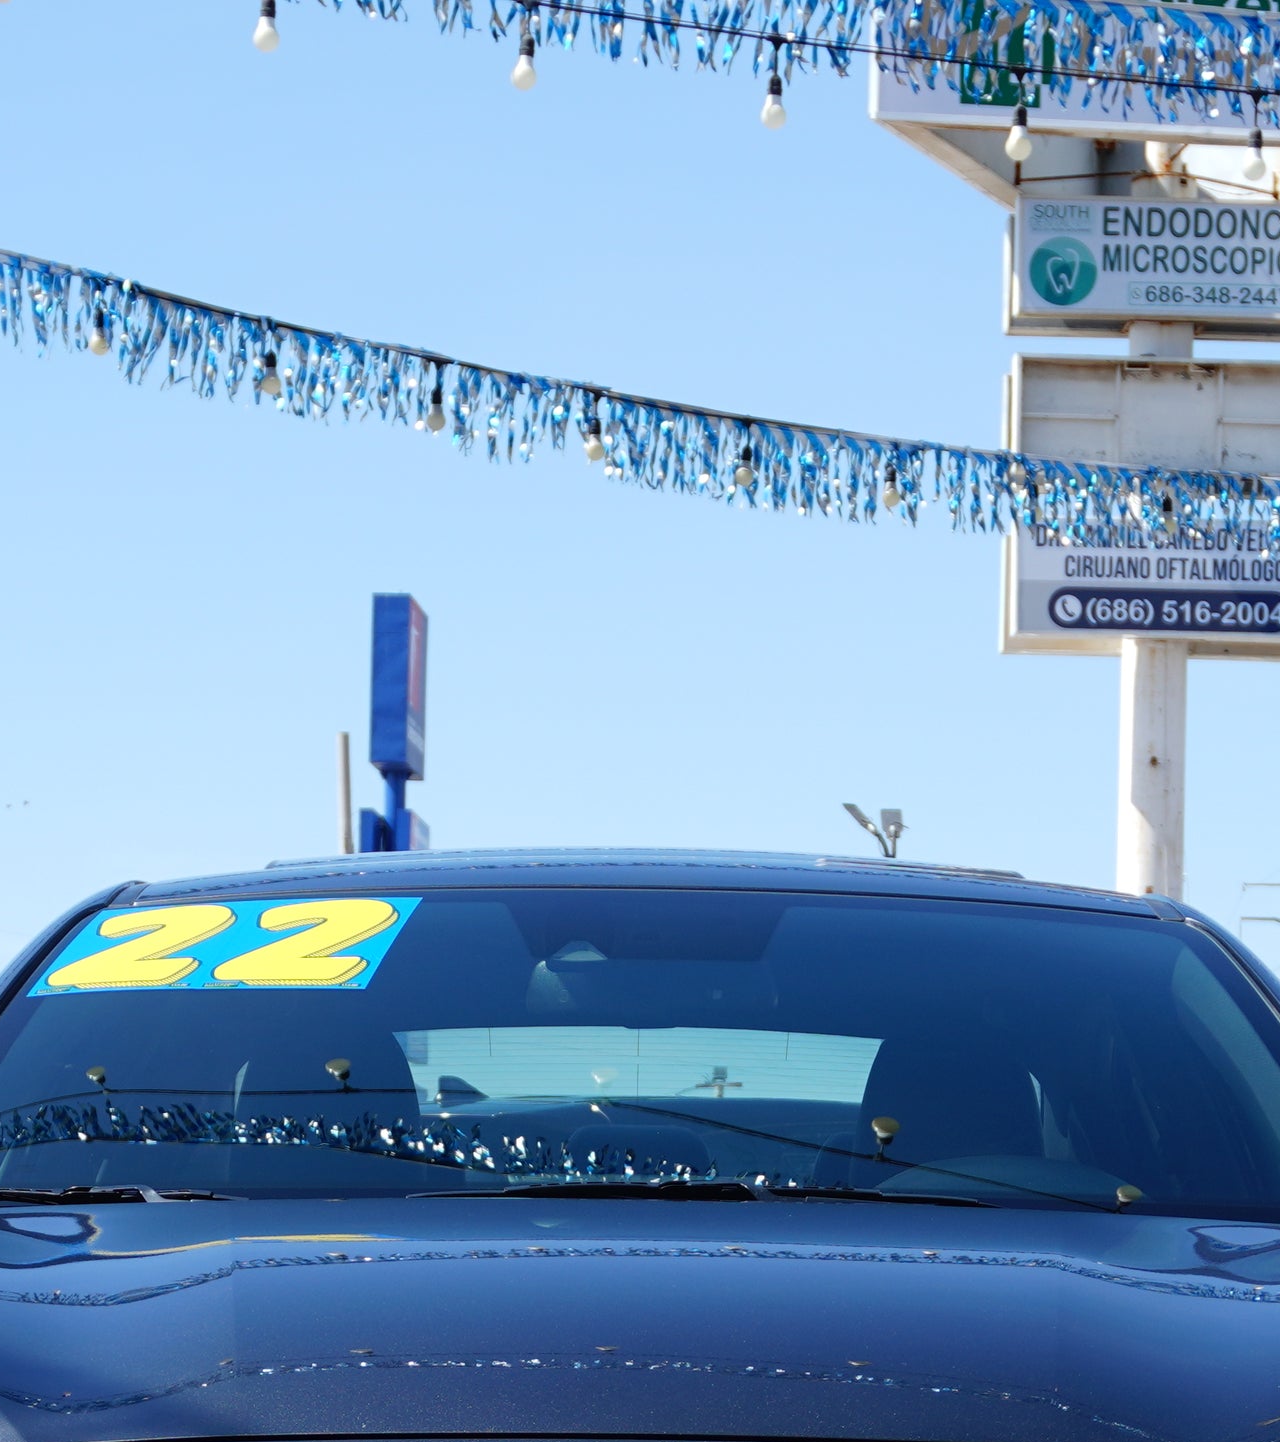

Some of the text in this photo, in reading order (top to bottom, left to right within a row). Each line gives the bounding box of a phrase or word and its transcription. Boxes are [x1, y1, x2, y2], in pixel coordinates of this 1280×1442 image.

[1033, 204, 1090, 218] SOUTH
[1064, 555, 1151, 579] CIRUJANO
[1086, 597, 1154, 625] (686)
[47, 899, 401, 989] 22
